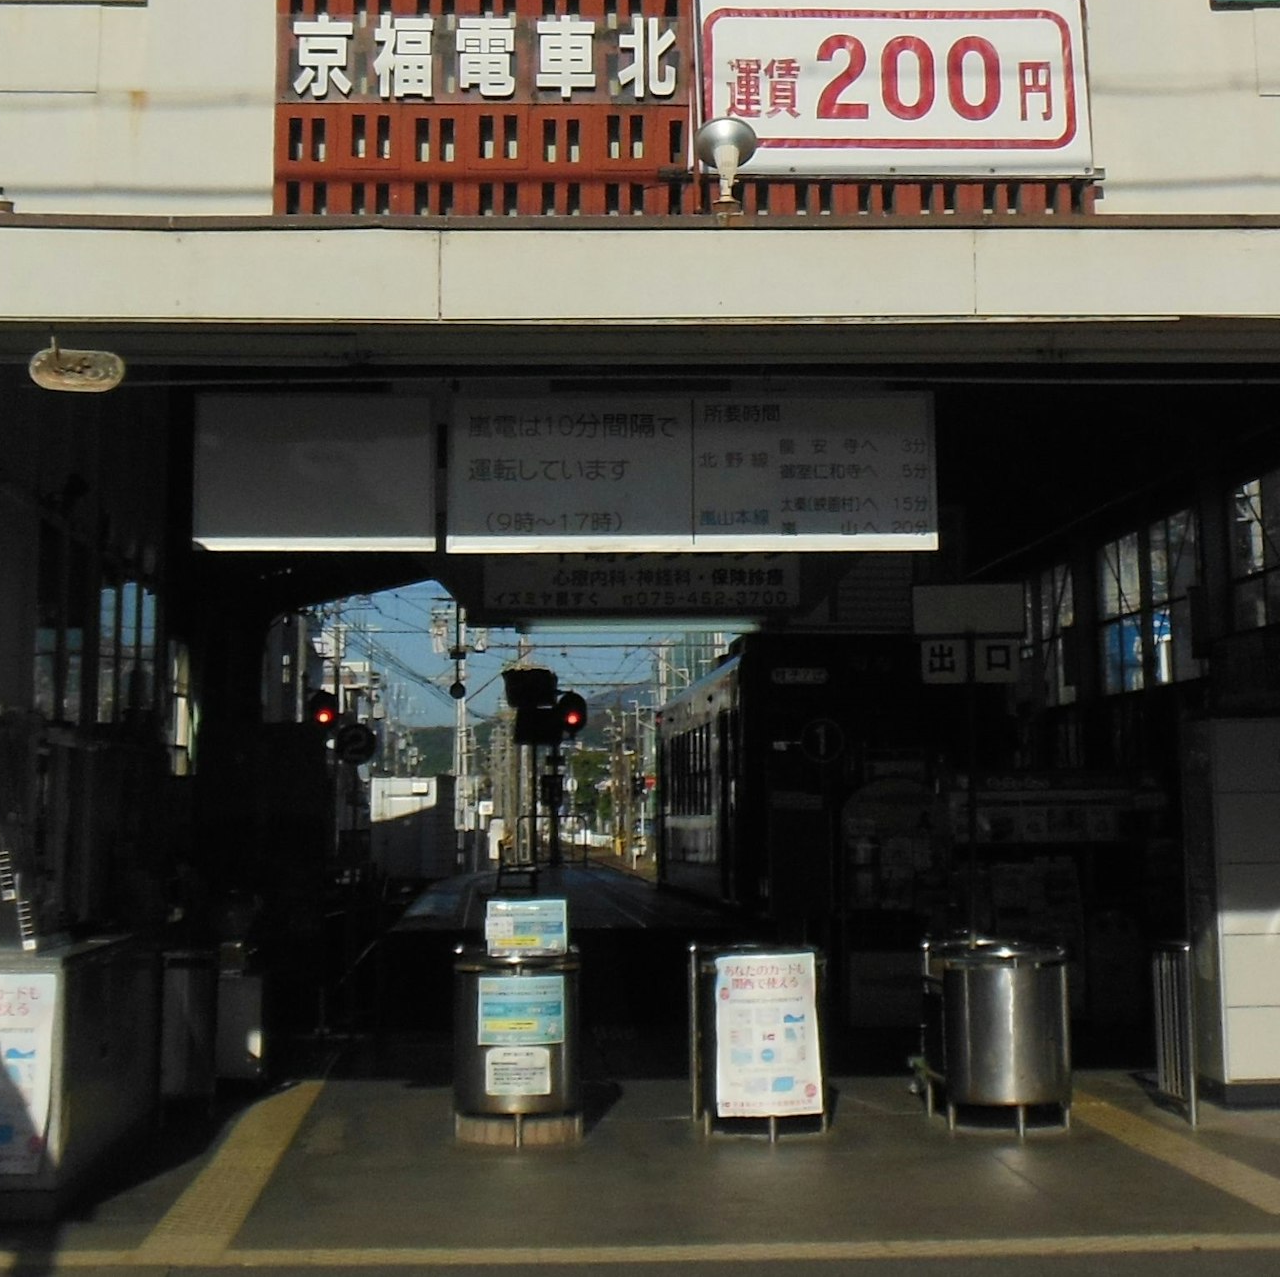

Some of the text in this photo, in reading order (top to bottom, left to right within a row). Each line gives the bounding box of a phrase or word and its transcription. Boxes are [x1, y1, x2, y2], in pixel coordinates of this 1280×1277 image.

[293, 15, 676, 98] 京福電車北
[703, 404, 781, 423] 所要時間
[468, 458, 630, 482] 運転しています
[929, 643, 1012, 671] 出口
